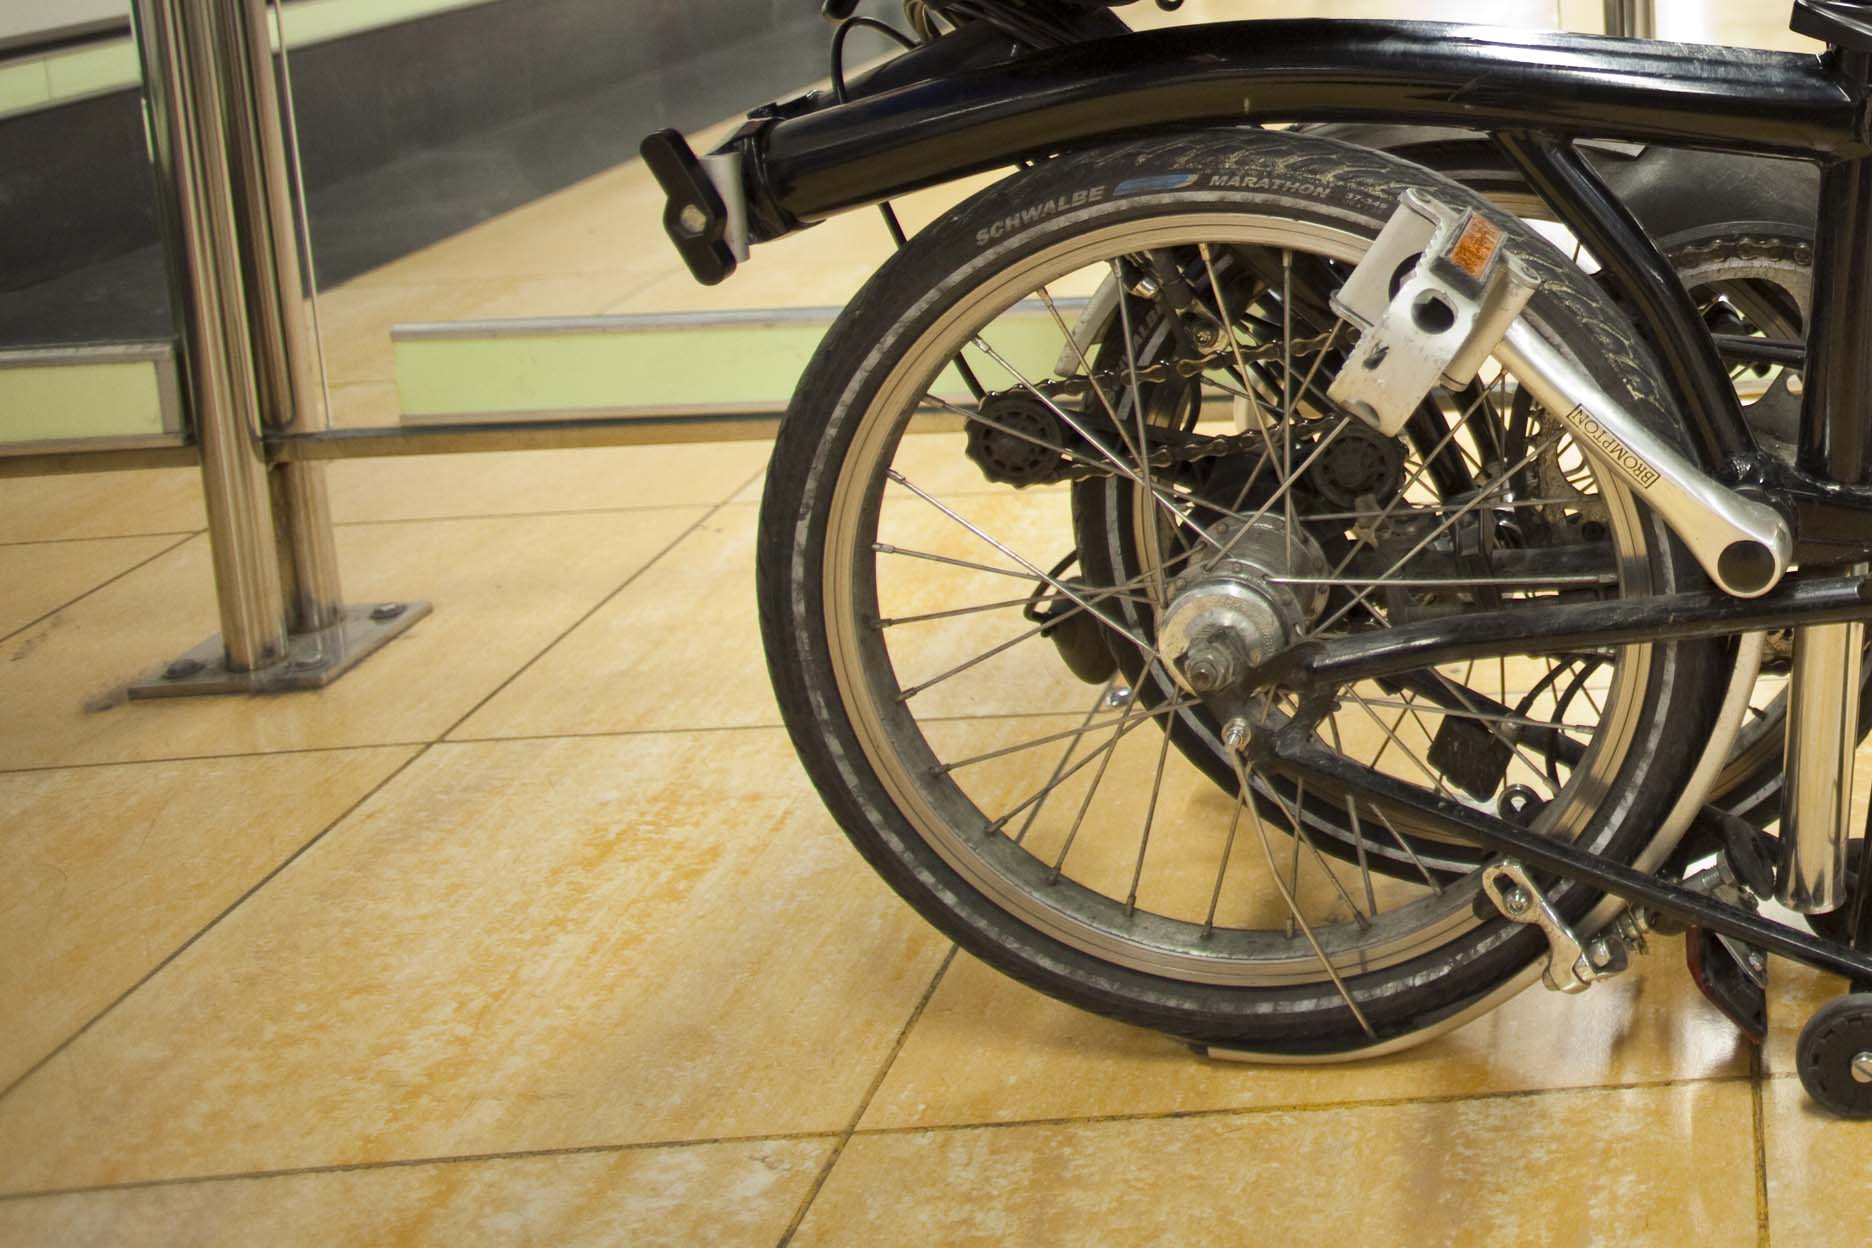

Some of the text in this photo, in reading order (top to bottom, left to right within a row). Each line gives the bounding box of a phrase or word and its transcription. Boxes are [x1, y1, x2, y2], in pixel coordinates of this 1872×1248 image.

[975, 184, 1106, 246] SCHWALBE
[1208, 175, 1332, 199] MARATHON
[1572, 408, 1655, 485] BROMPTON
